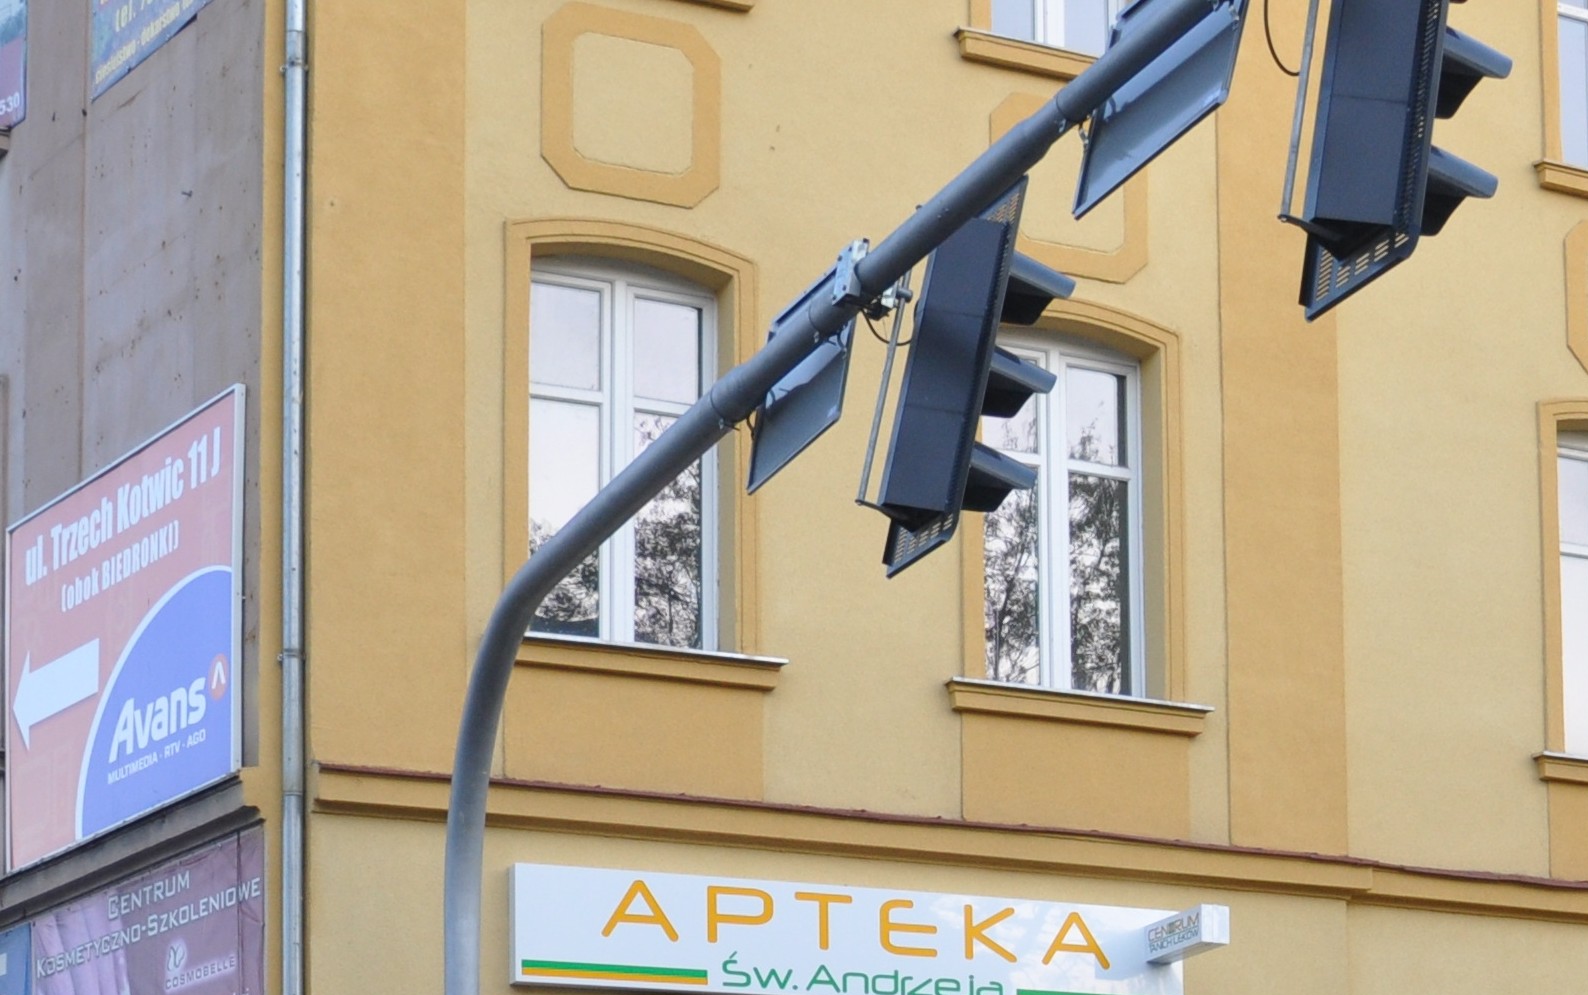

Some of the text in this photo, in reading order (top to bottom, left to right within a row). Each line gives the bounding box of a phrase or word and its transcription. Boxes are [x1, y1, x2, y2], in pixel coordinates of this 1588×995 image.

[25, 534, 47, 586] ul.
[51, 496, 113, 571] Trzech
[117, 456, 184, 534] Kotwic
[61, 519, 180, 613] (obok BIEDRONKI)
[108, 677, 207, 764] Avans
[108, 751, 158, 785] MULTIMEDIA
[164, 740, 181, 759] RTV
[36, 877, 261, 979] KOSMETYCZNO-SZKOLENIOWE
[108, 870, 190, 919] CENTRUM
[601, 879, 1111, 970] APTEKA
[165, 954, 236, 990] COSMOBELLE
[722, 951, 798, 991] Św.
